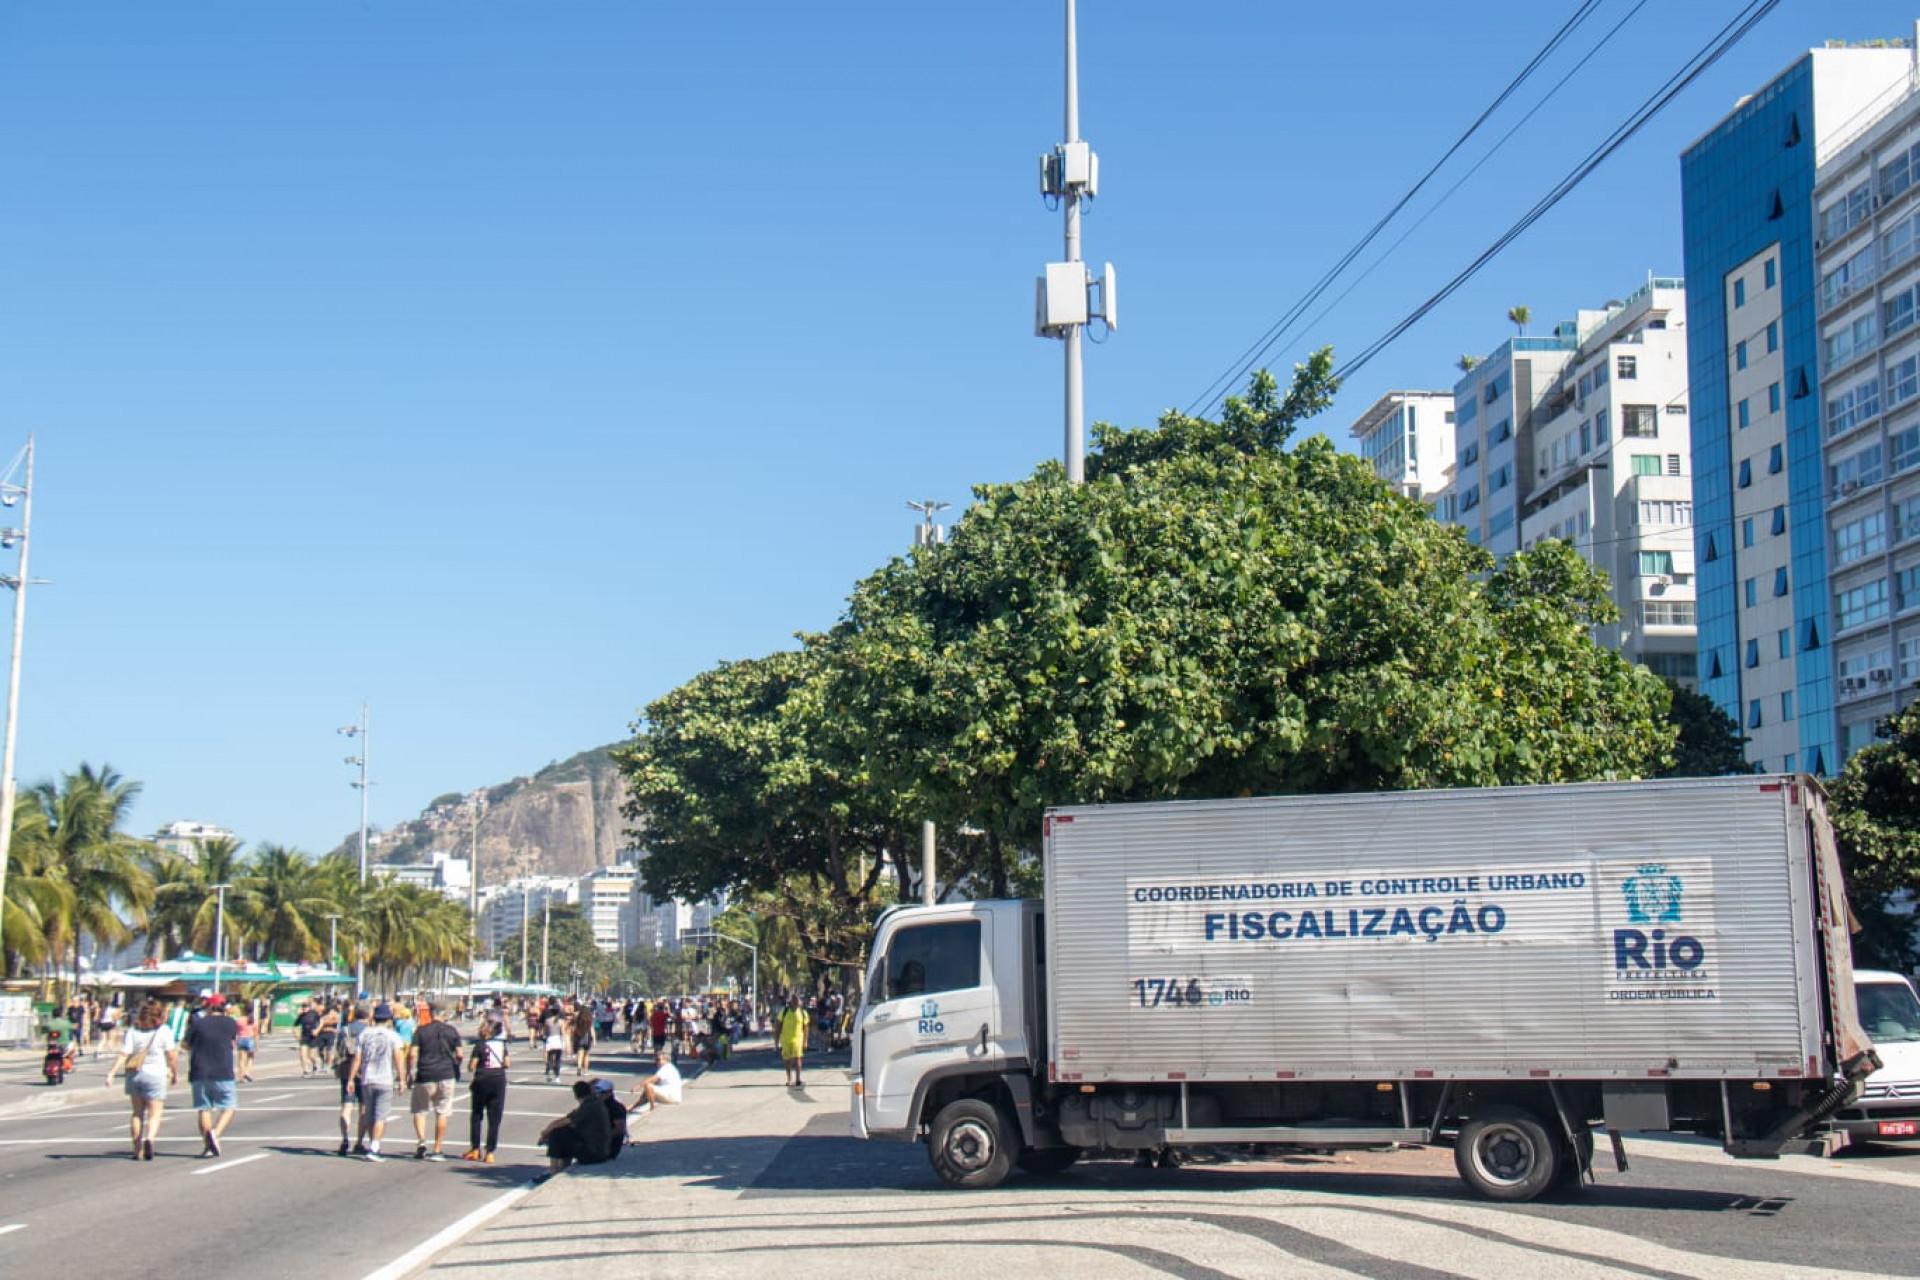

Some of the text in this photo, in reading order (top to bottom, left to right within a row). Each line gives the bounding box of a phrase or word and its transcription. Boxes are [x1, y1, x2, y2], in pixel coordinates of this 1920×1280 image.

[1134, 873, 1585, 902] COORDENADORIA DE CONTROLE URBANO
[1204, 899, 1506, 942] FISCALIZAÇÃO
[1614, 928, 1705, 970] Rio
[1134, 978, 1201, 1008] 1746
[1224, 988, 1250, 1000] RIO
[1610, 990, 1656, 1000] ORDEM
[918, 1019, 944, 1033] Rio
